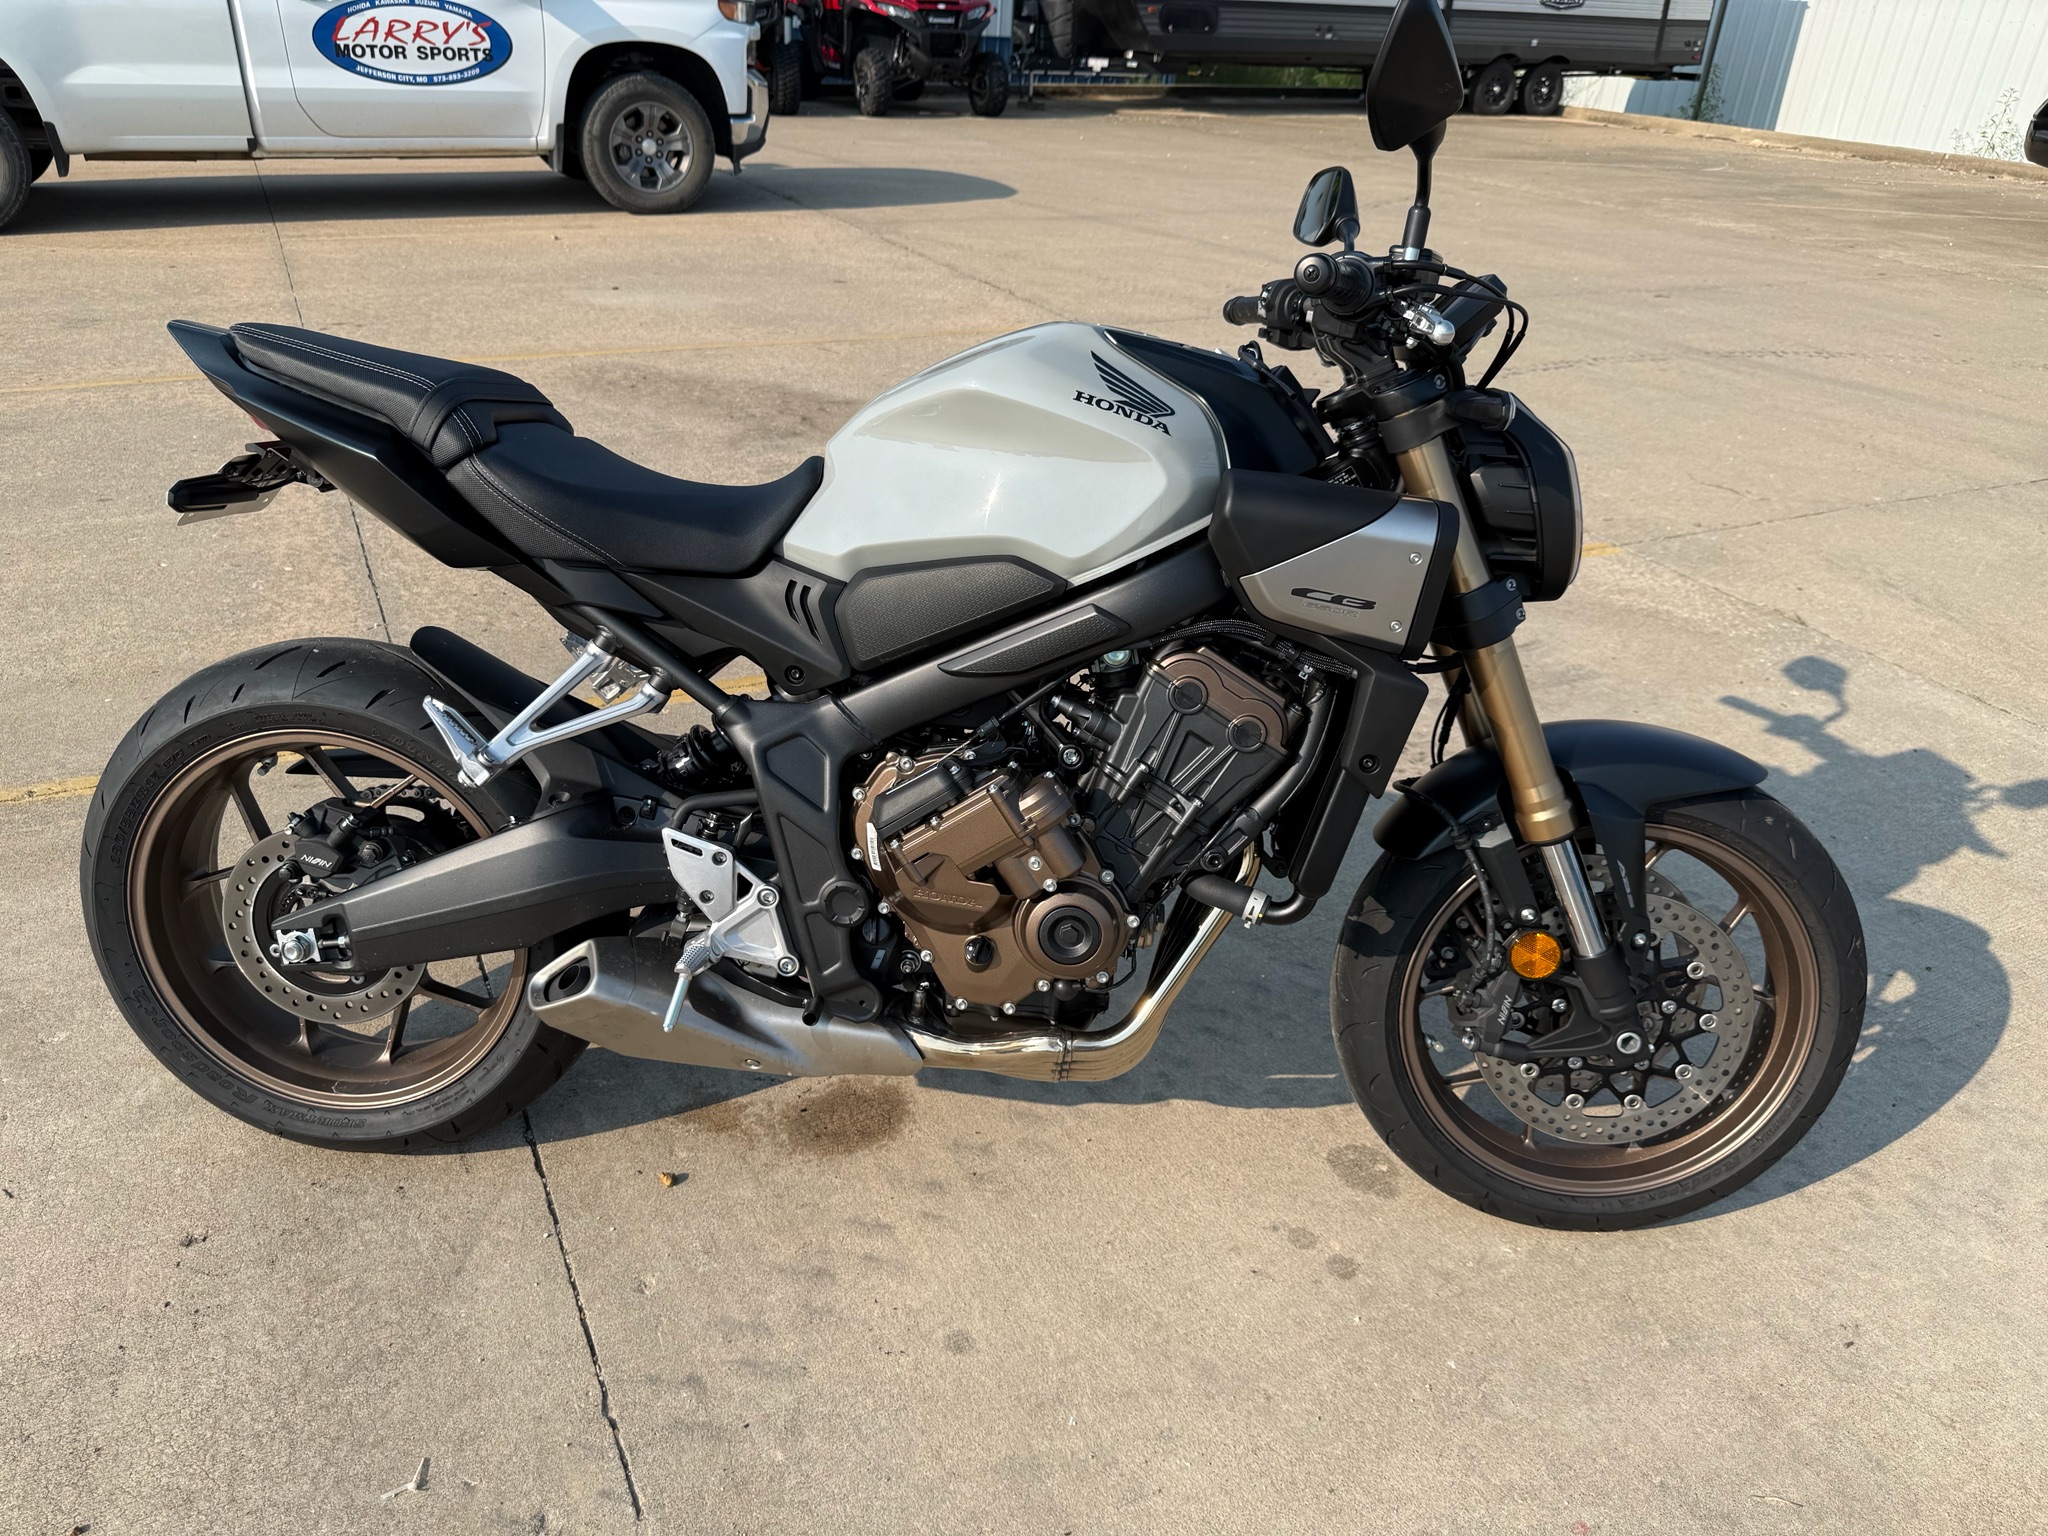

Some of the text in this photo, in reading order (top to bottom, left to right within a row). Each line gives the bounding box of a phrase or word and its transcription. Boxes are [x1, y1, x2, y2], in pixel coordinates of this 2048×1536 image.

[347, 1, 371, 14] HONDA
[444, 3, 473, 18] YAMAHA
[331, 16, 493, 47] LARRY'S
[335, 42, 494, 62] MOTOR SPORTS
[356, 65, 397, 80] JEFFERSON
[416, 75, 428, 83] MO
[1072, 389, 1172, 437] HONDA
[1290, 587, 1377, 610] CB
[912, 888, 983, 909] HONDA
